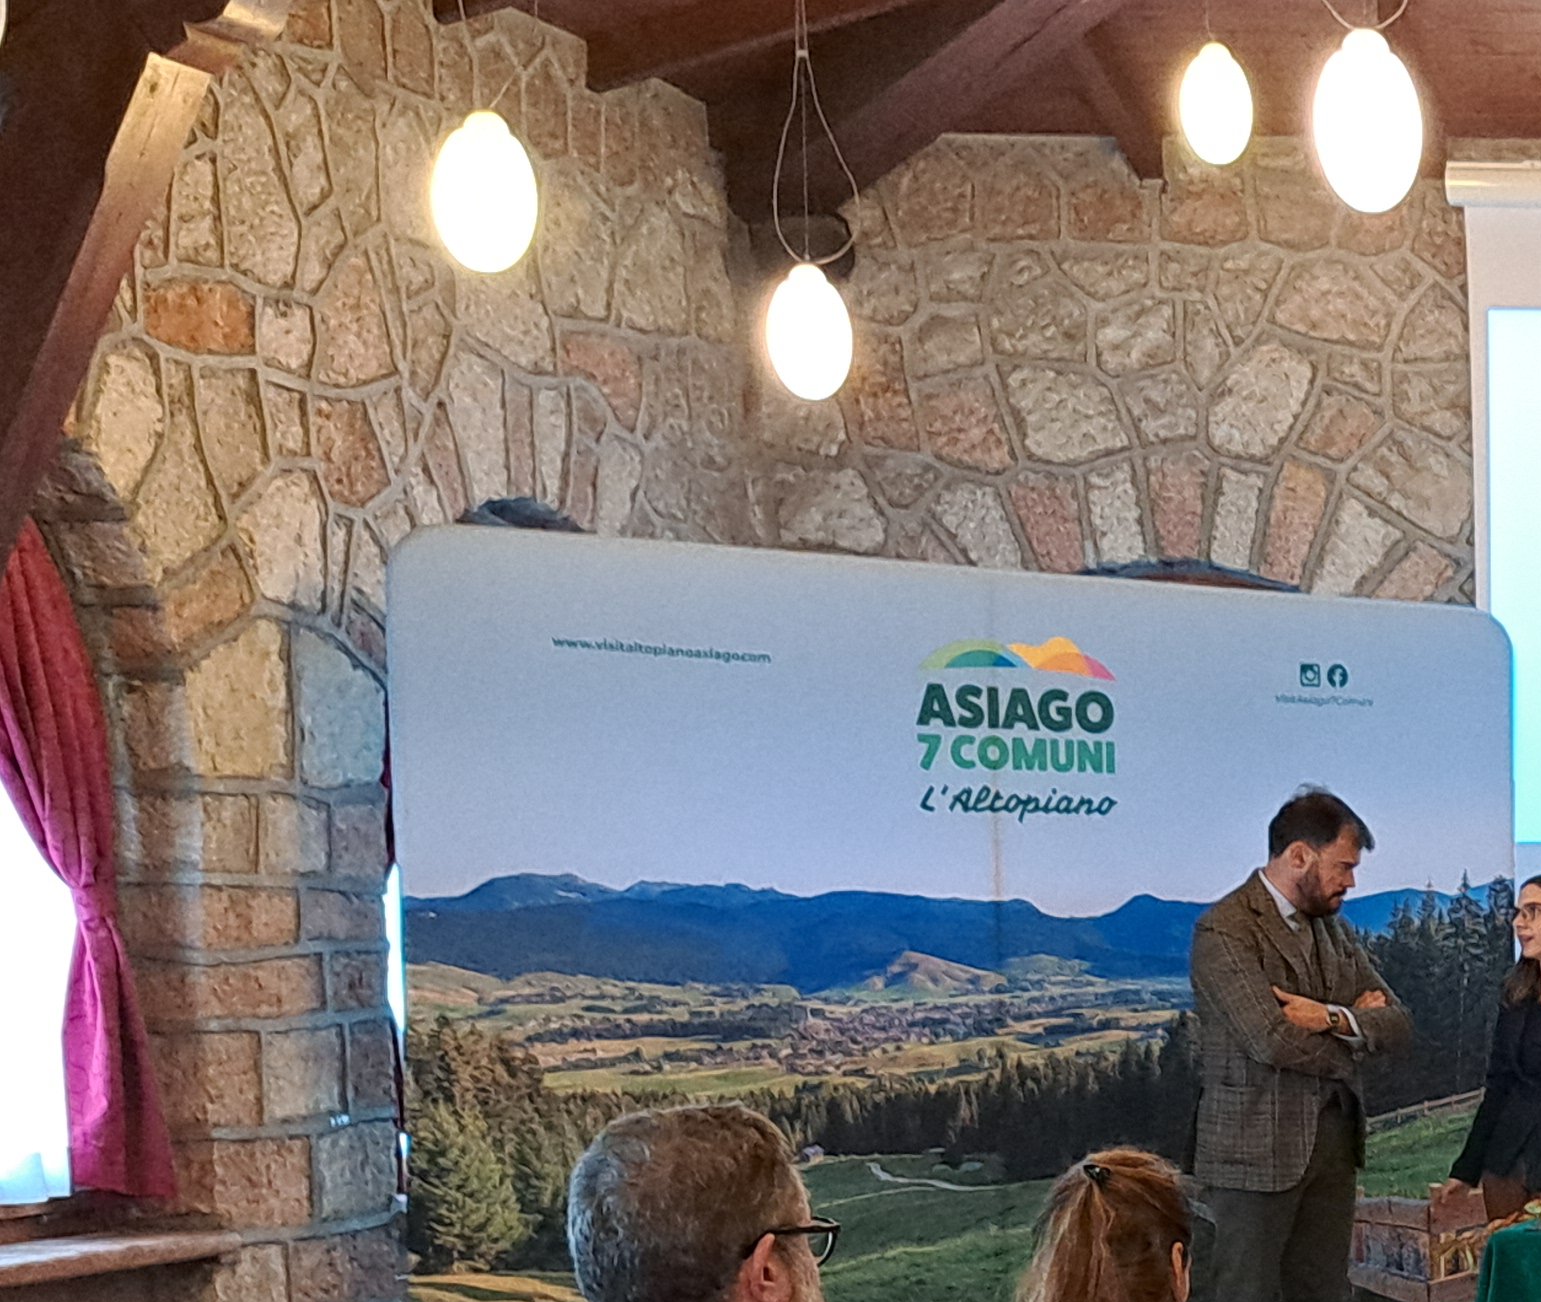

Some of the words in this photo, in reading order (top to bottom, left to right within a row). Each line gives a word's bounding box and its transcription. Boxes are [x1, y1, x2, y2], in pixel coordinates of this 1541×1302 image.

[916, 683, 1115, 734] ASIAGO
[917, 733, 942, 771] 7
[950, 734, 1116, 774] COMUNI
[920, 784, 1118, 824] L'Altopiano
